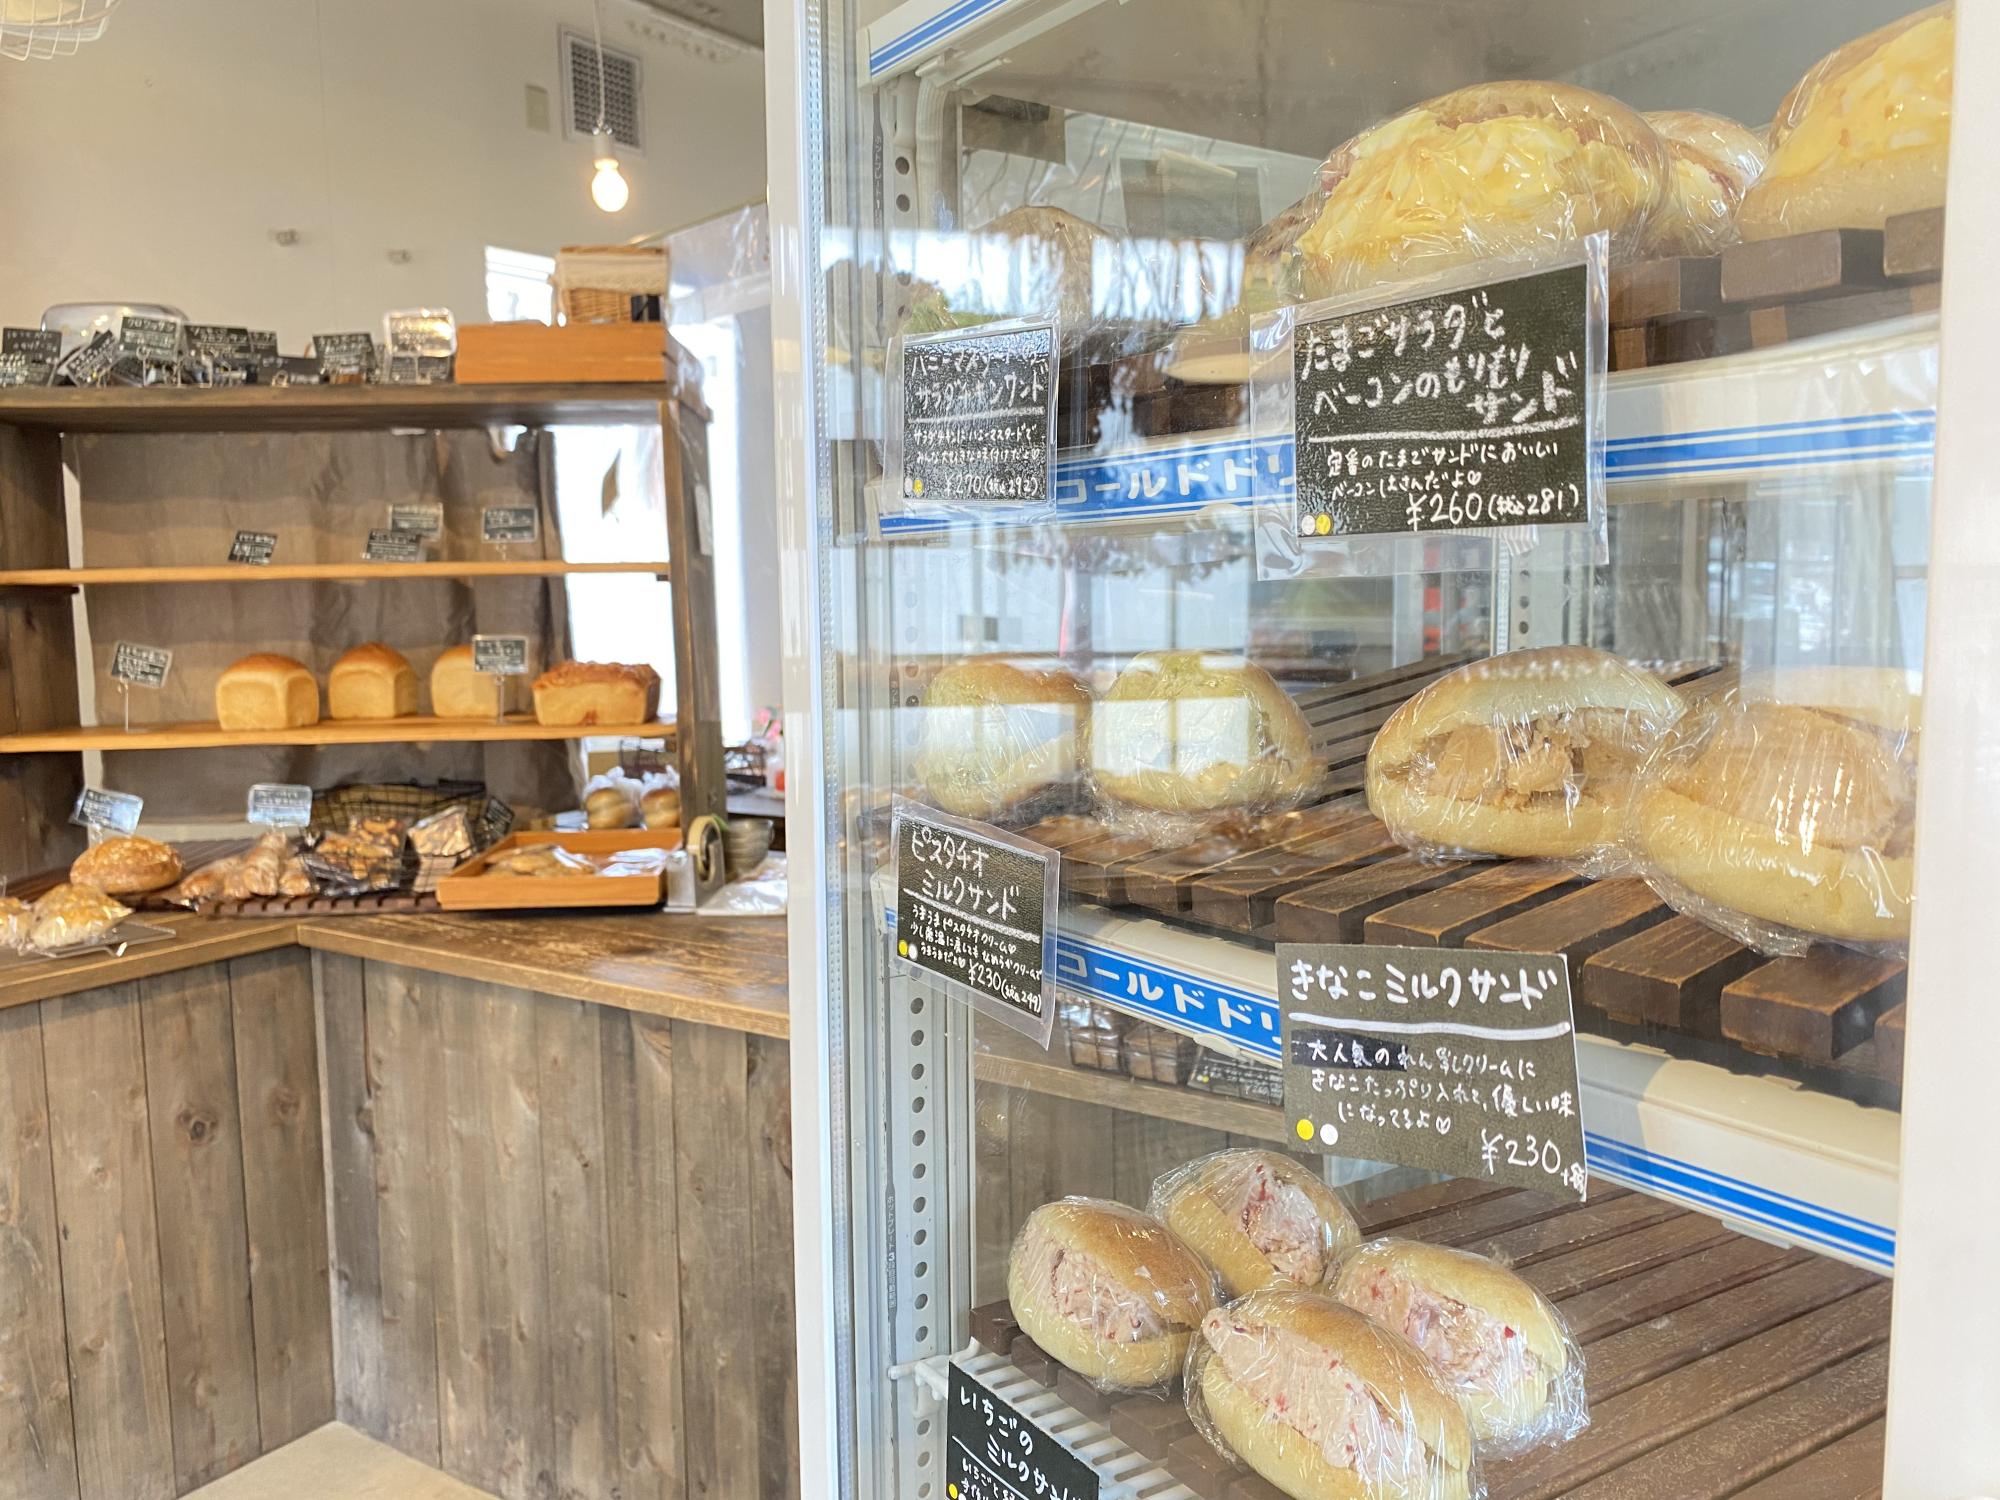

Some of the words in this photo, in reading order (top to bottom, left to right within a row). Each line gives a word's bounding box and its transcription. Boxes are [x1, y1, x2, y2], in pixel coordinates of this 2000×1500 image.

[1301, 290, 1505, 380] たまごサラダと
[1314, 344, 1530, 414] ベーコンのもりもり
[1466, 351, 1578, 424] サンド
[1328, 441, 1557, 477] 定番のたまごサンドにおいしい
[911, 827, 990, 878] ピスタチオ
[922, 868, 1020, 920] ミルクサンド
[1290, 958, 1558, 1010] きなこミルクサンド
[961, 1386, 1034, 1456] いちごの
[987, 1434, 1082, 1500] ミルクサン
